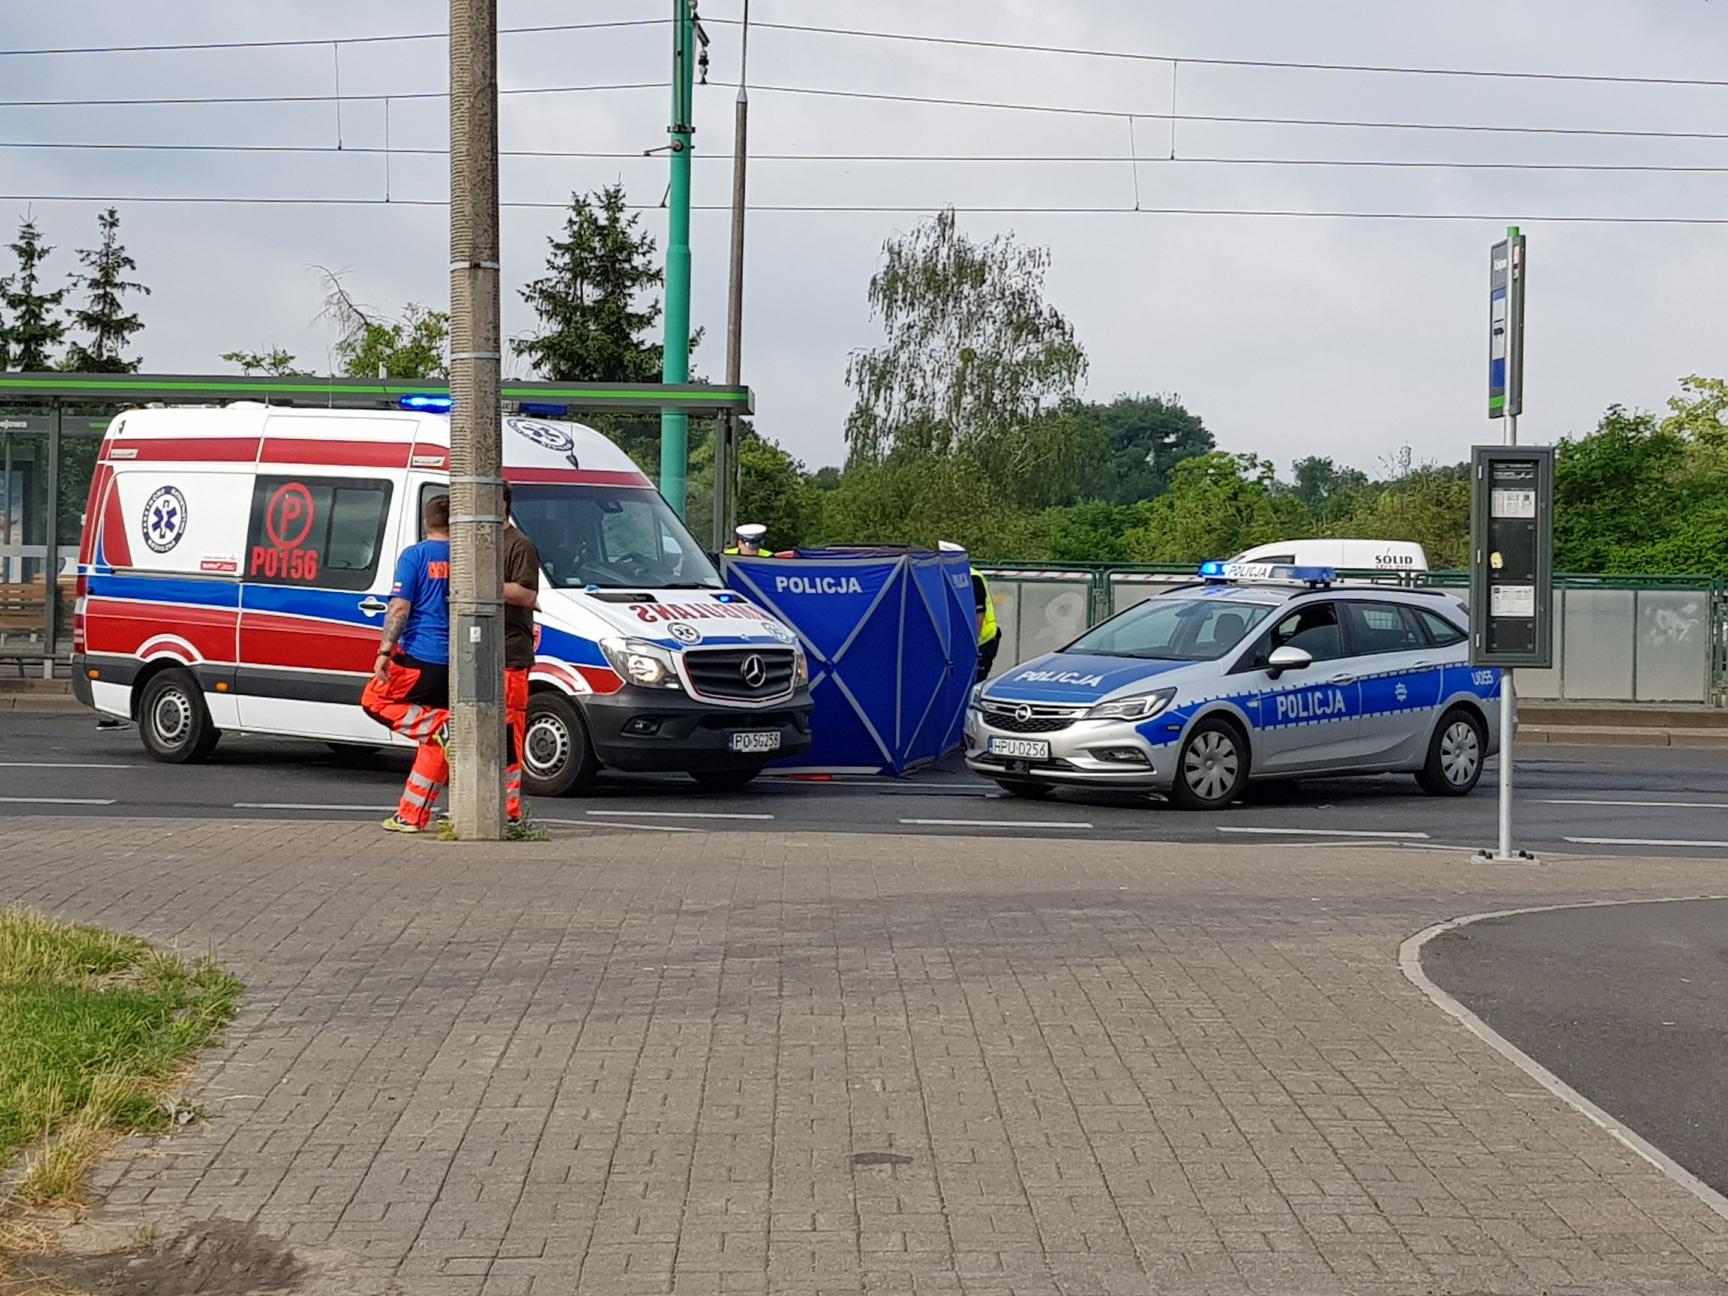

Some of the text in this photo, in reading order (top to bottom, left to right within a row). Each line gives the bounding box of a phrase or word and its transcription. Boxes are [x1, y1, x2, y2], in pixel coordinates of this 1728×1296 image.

[1228, 565, 1268, 577] POLICJA
[775, 576, 863, 594] POLICJA
[1013, 670, 1104, 687] POLICJA
[1276, 689, 1346, 721] POLICJA
